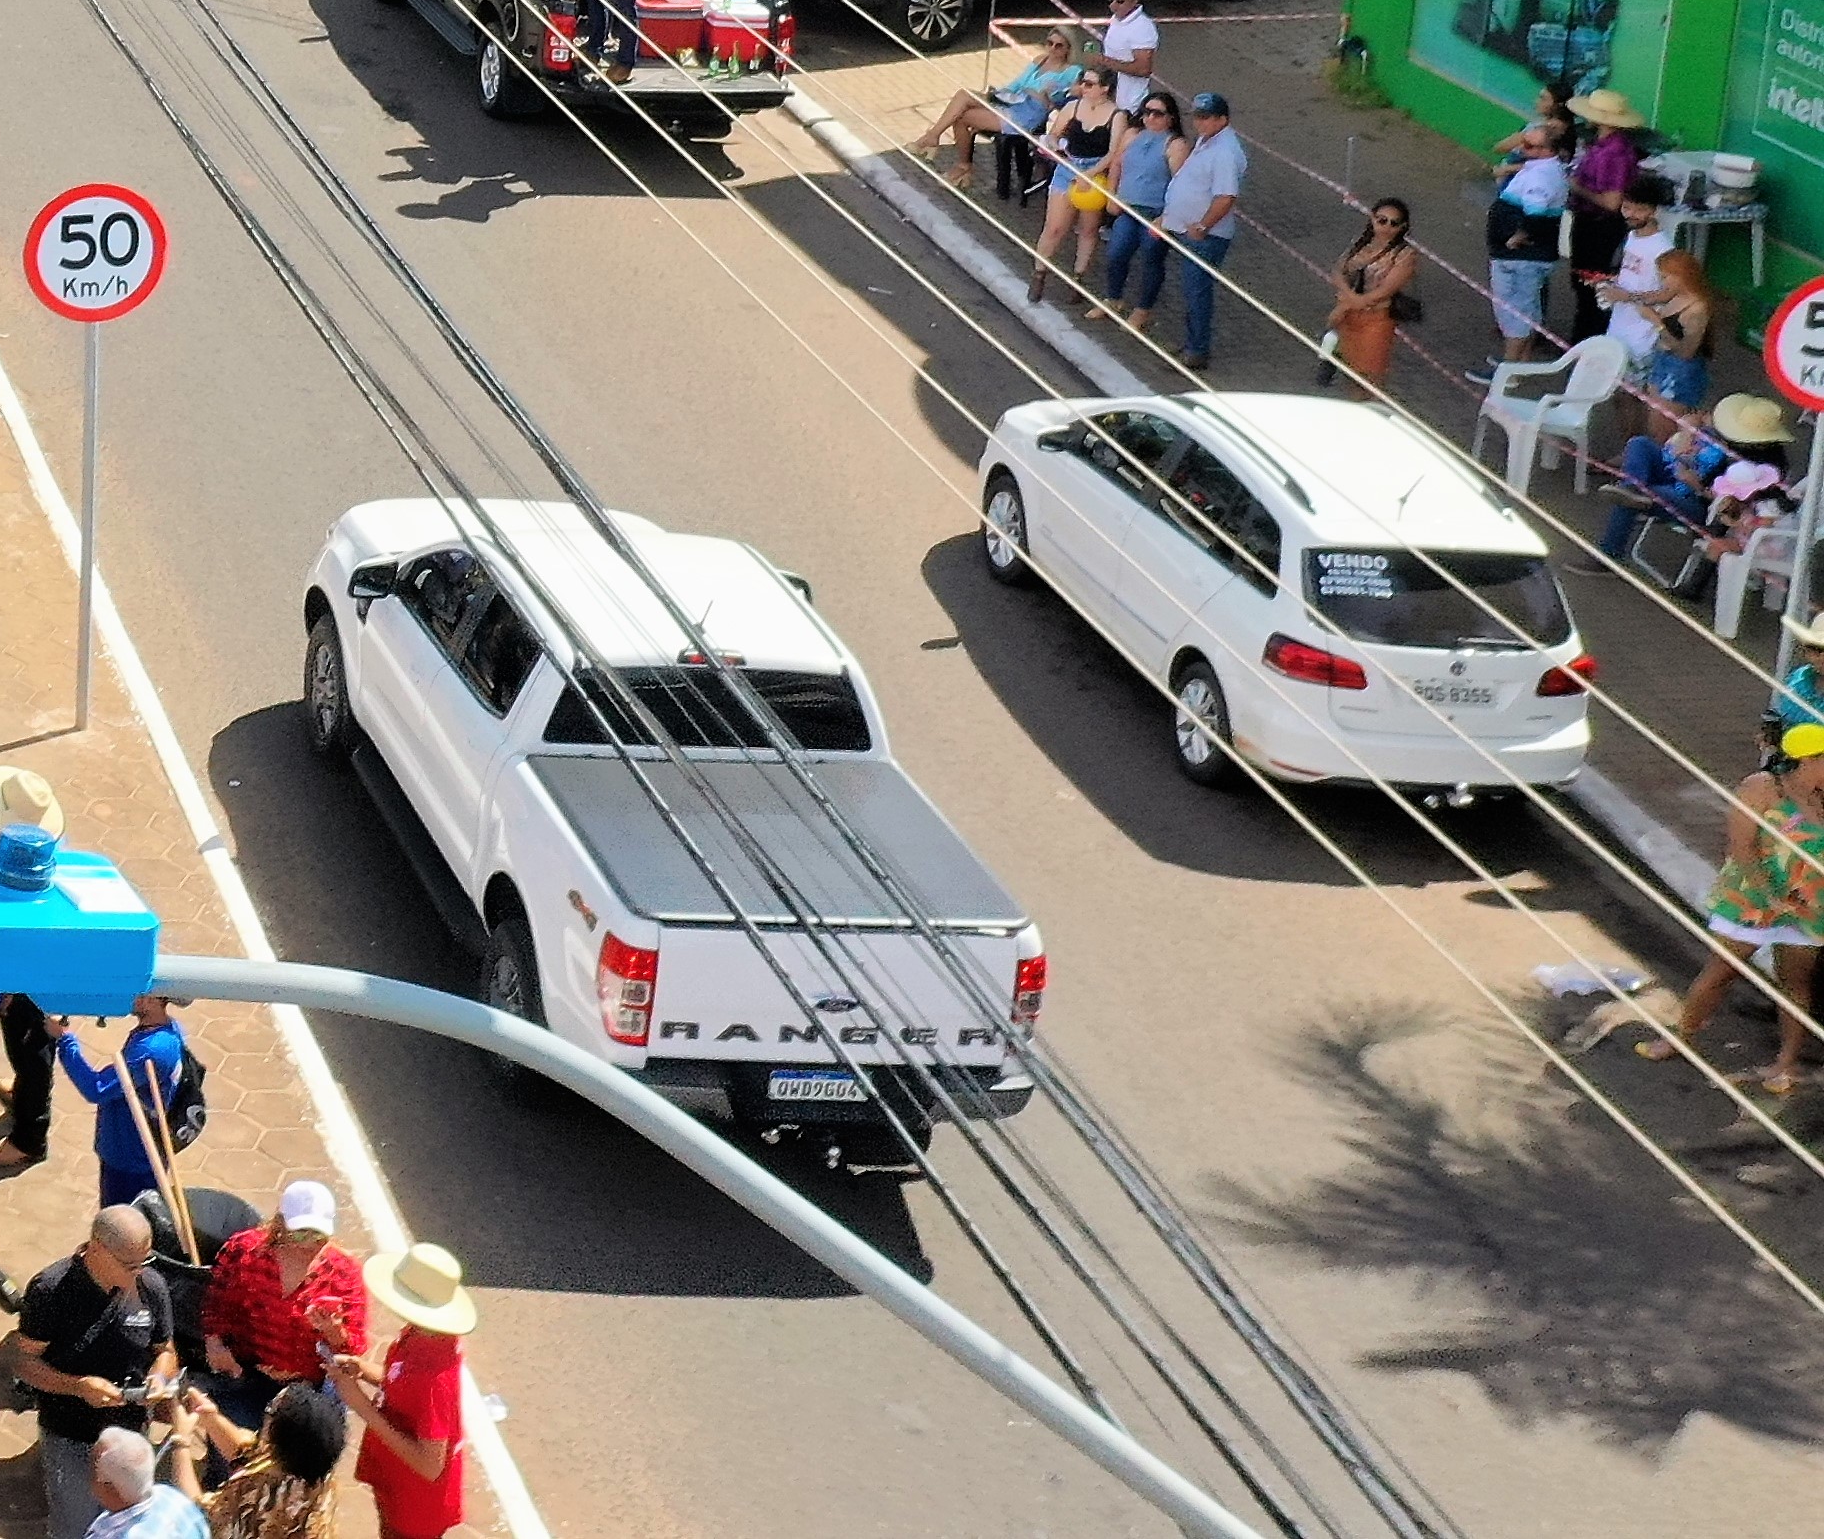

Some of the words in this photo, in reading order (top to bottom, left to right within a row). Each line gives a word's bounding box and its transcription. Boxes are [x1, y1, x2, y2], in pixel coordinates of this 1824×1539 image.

[58, 211, 140, 271] 50
[62, 275, 129, 299] Km/h
[1318, 552, 1389, 571] VENDO
[659, 1020, 1001, 1047] RANGER
